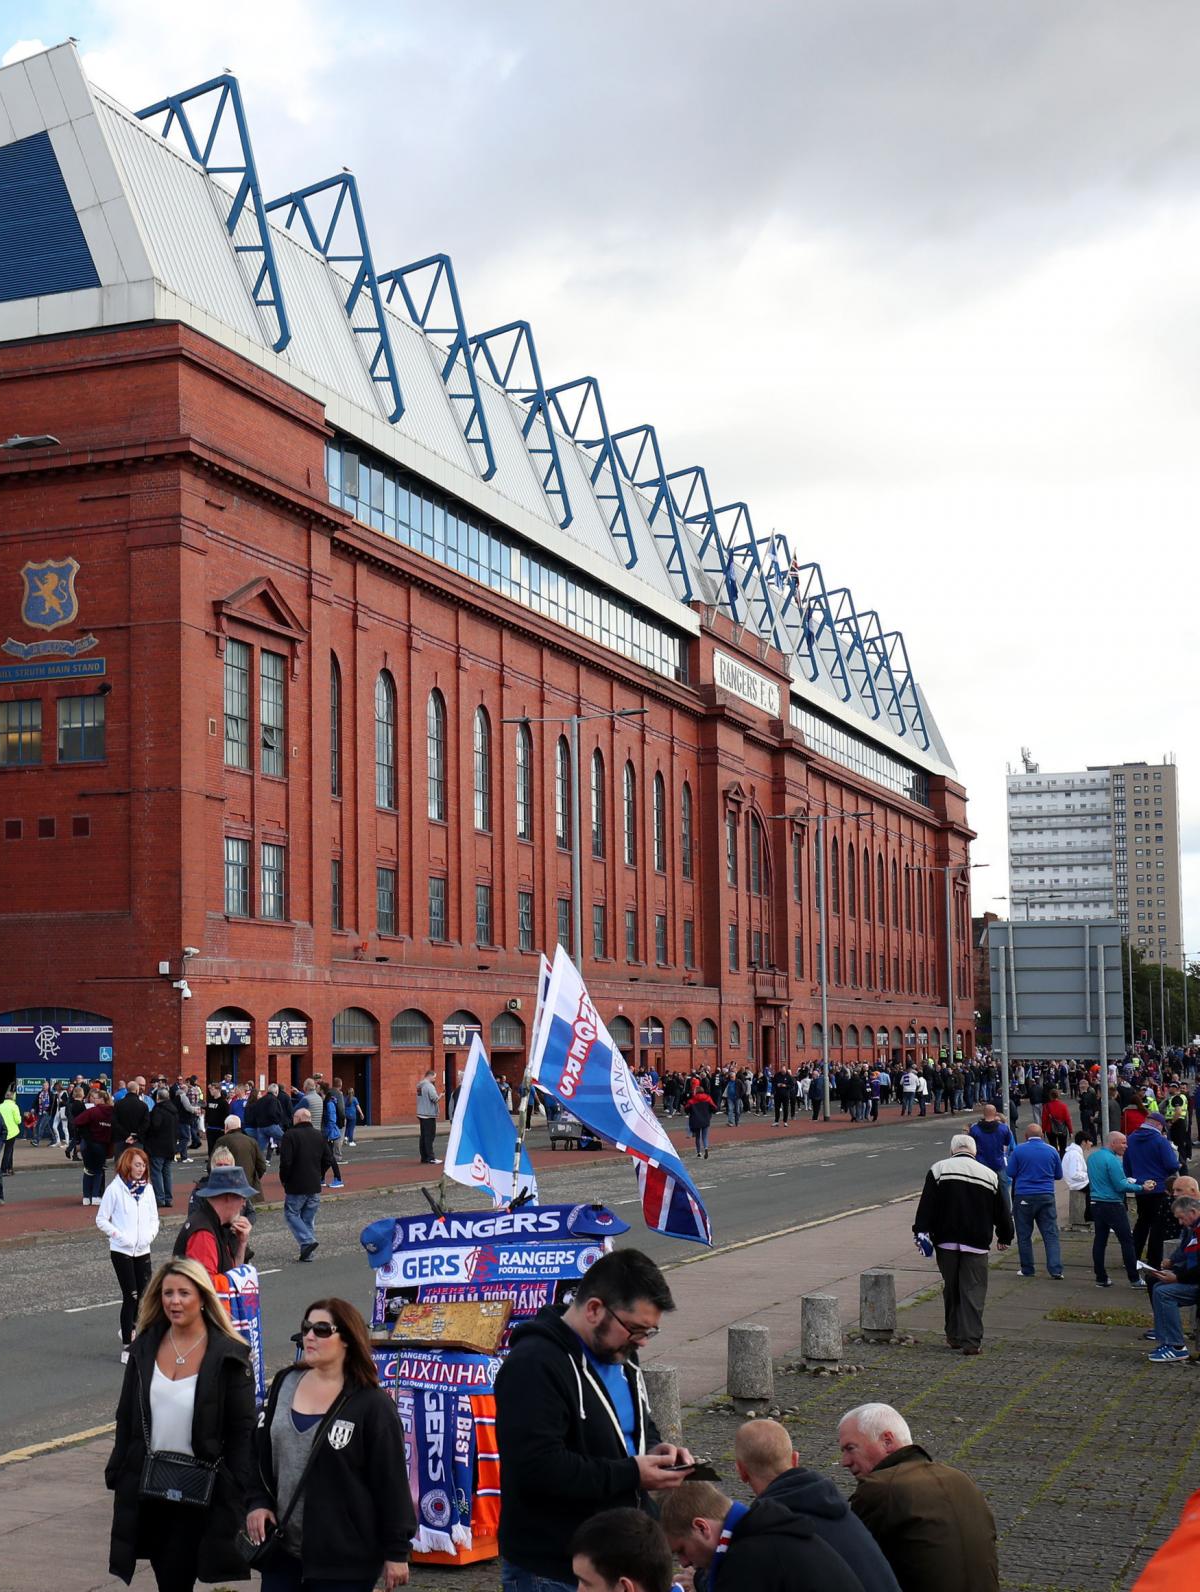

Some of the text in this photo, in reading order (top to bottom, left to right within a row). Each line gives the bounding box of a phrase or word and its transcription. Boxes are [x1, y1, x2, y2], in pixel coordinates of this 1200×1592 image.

[48, 665, 70, 674] MAIN
[72, 663, 100, 673] STAND
[720, 658, 757, 701] RANGERS
[409, 1212, 560, 1243] RANGERS
[402, 1254, 460, 1280] GERS
[499, 1251, 575, 1266] RANGERS
[498, 1266, 560, 1275] FOOTBALL CLUB
[425, 1283, 549, 1295] THERE'S ONLY ONE
[432, 1354, 443, 1362] FC
[384, 1360, 486, 1384] CAIXINHA
[455, 1416, 472, 1467] BEST
